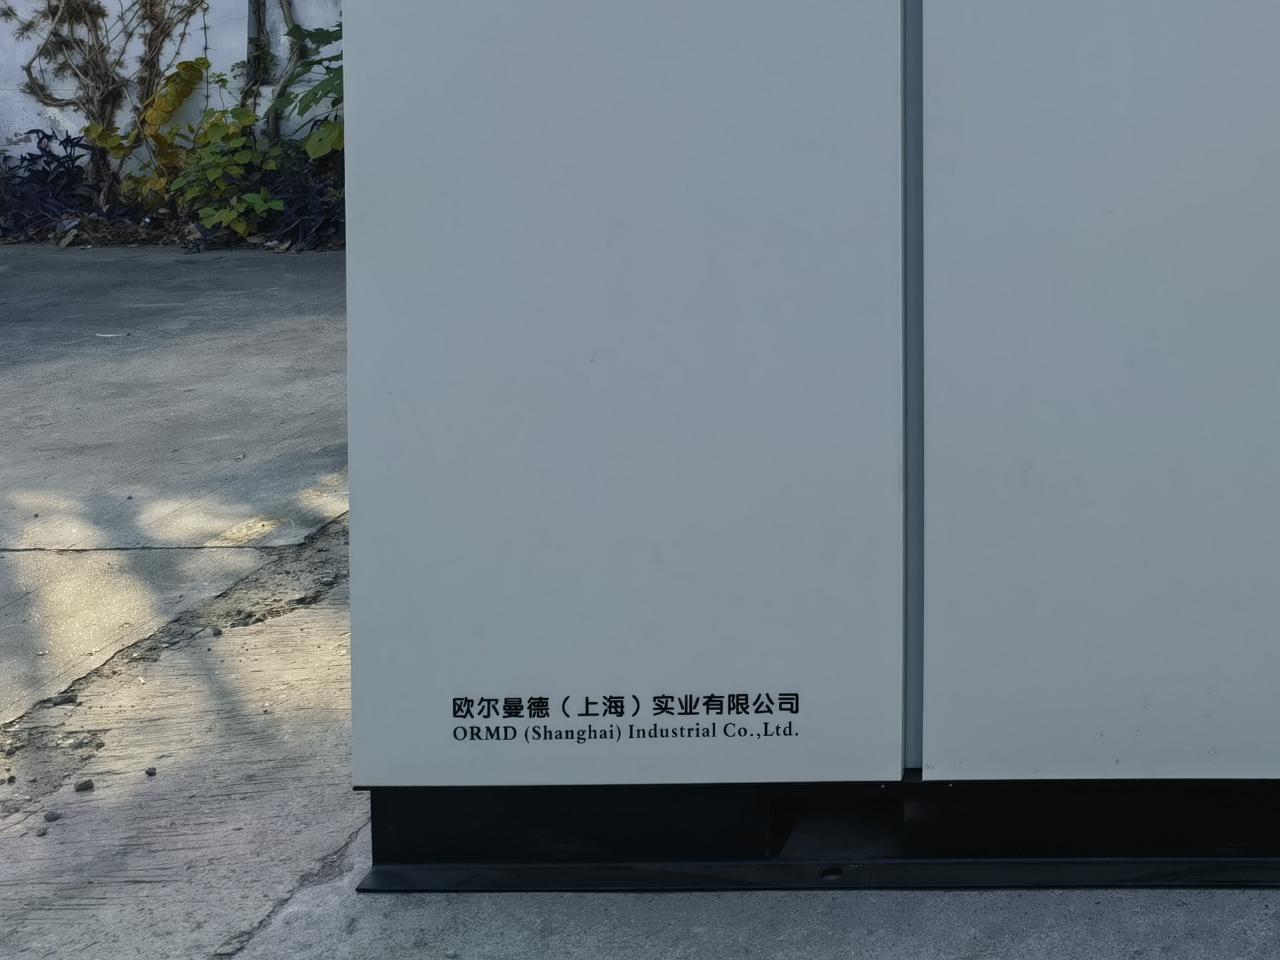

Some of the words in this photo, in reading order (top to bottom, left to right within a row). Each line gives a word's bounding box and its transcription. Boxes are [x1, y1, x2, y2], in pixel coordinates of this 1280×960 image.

[452, 692, 800, 719] 欧尔曼德（上海）实业有限公司
[452, 725, 518, 741] ORMD
[524, 722, 622, 744] (Shanghai)
[628, 722, 717, 739] Industrial
[722, 720, 799, 740] Co.,Ltd.
